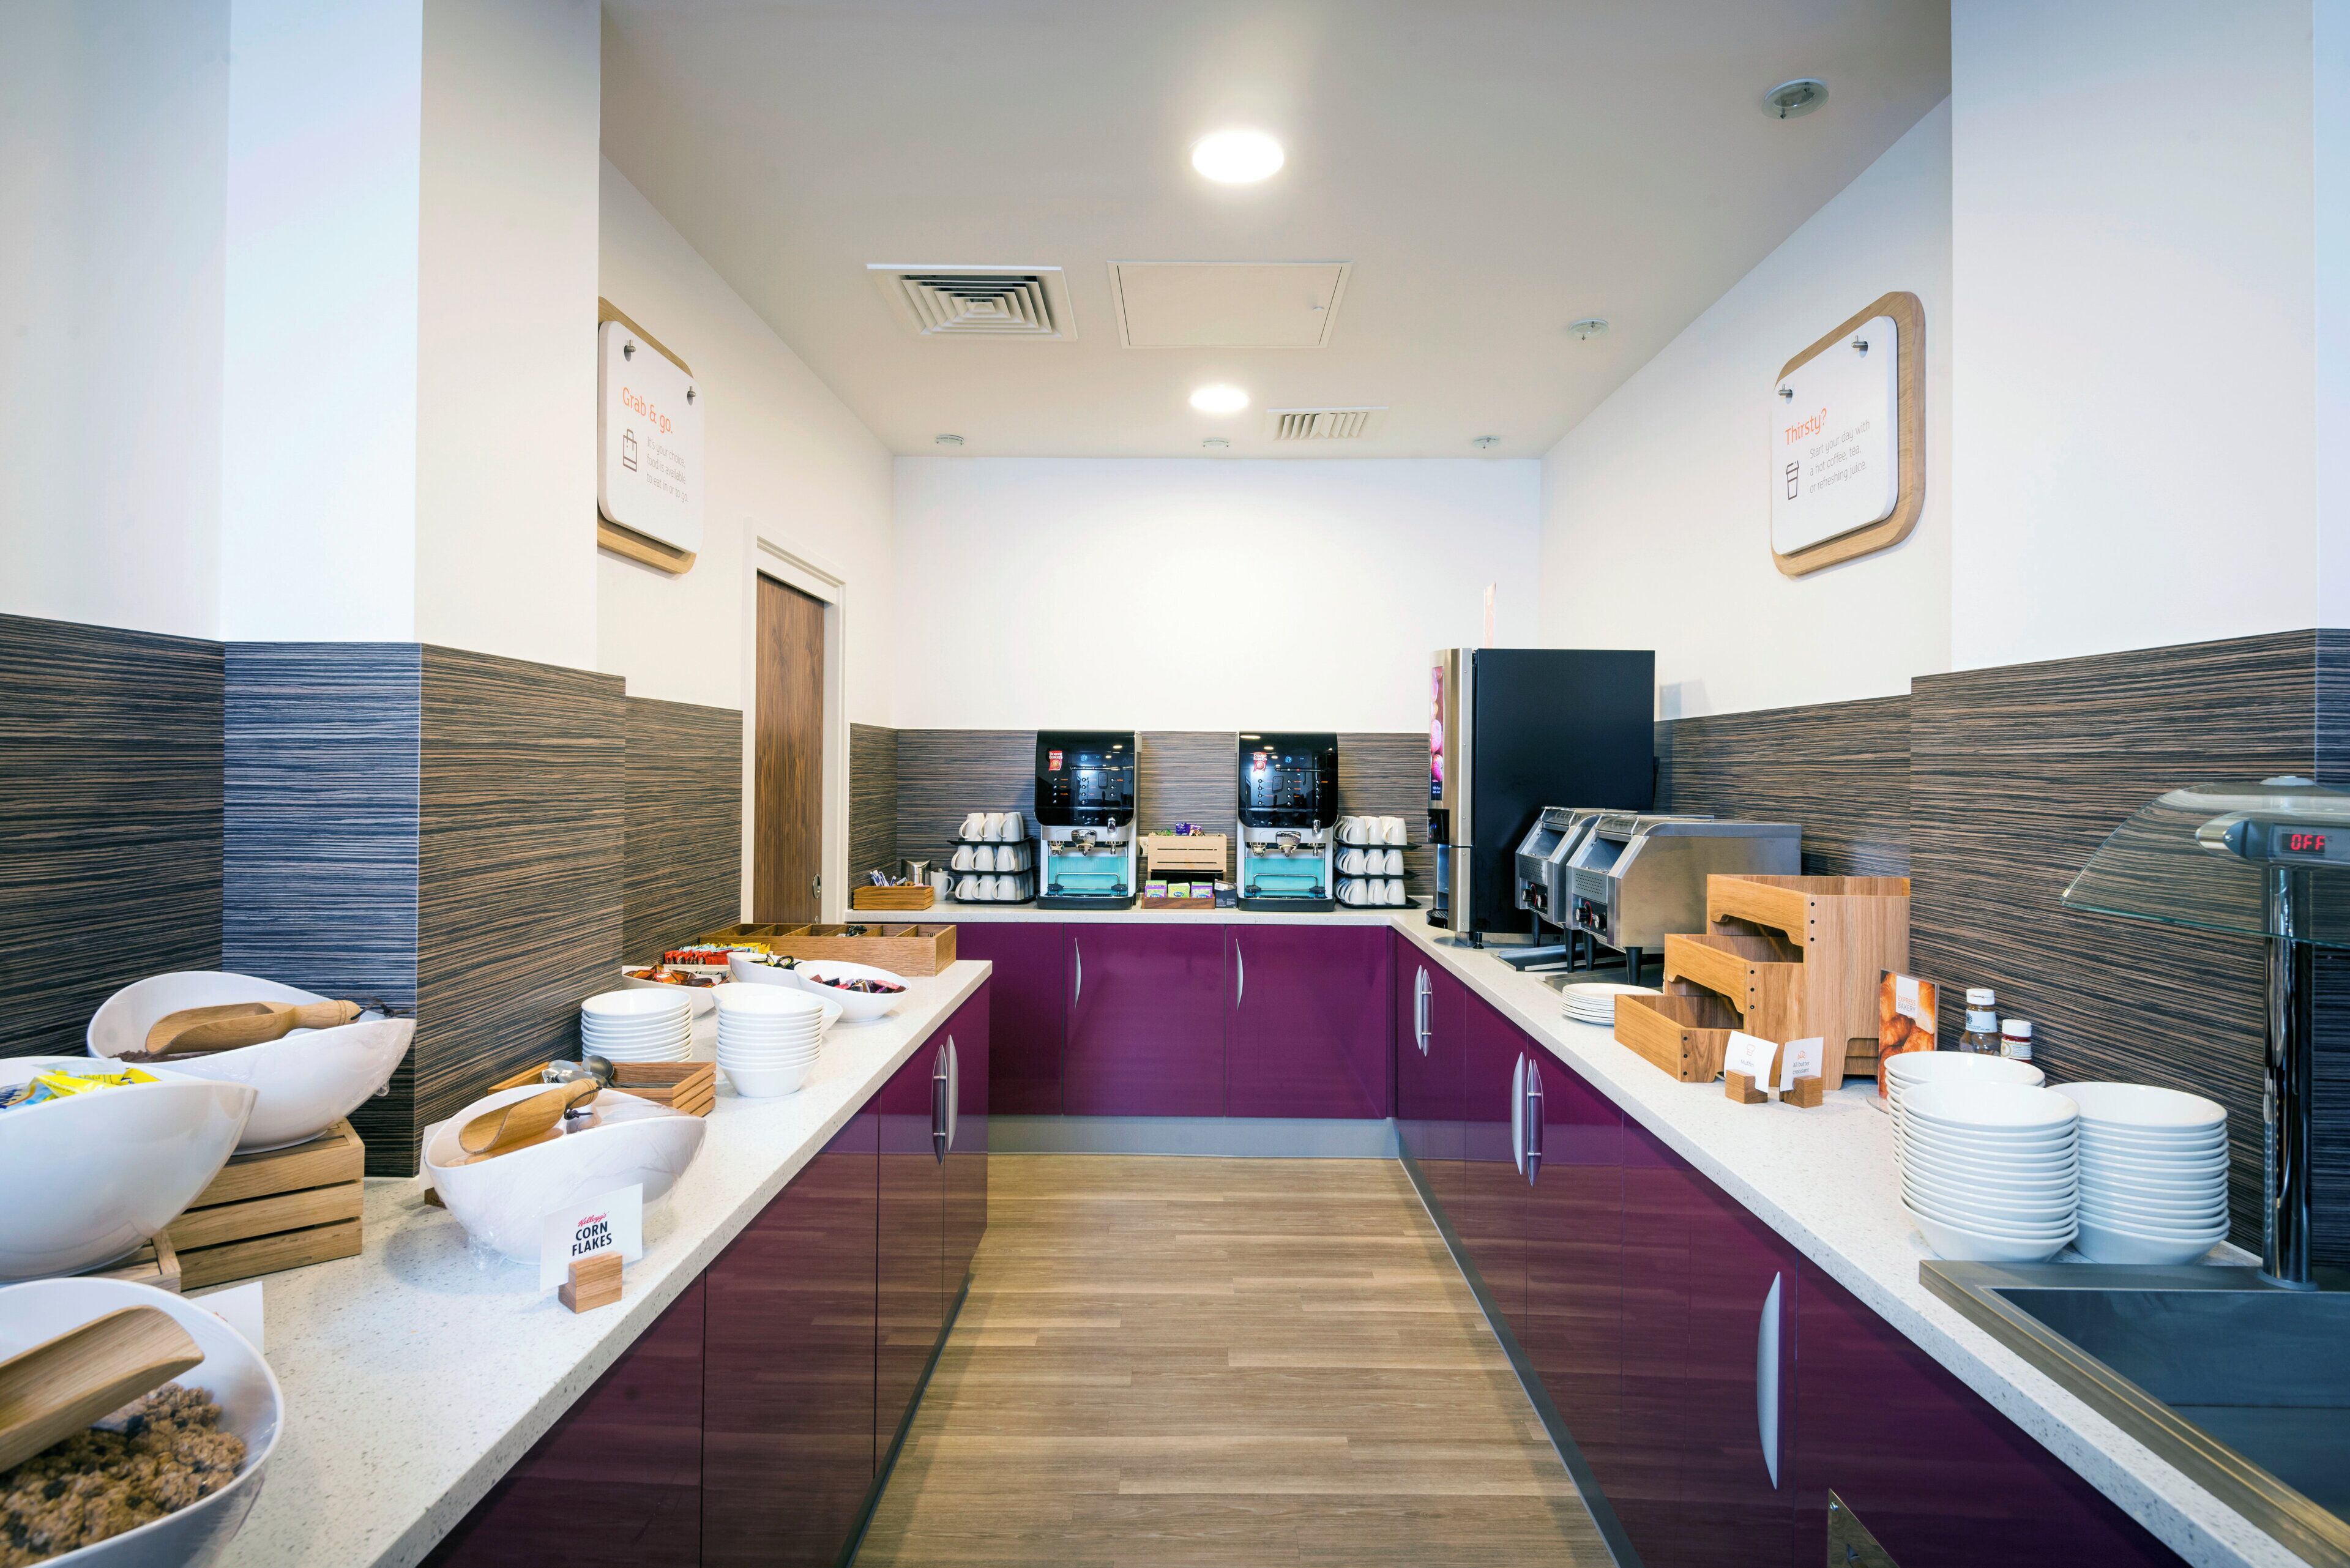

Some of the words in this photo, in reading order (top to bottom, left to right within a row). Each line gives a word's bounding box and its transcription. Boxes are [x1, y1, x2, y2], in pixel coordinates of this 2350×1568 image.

[622, 387, 646, 416] Grab
[649, 404, 657, 424] &
[660, 414, 673, 433] go.
[1785, 408, 1827, 446] Thirsty?
[1810, 444, 1824, 459] Start
[1826, 436, 1840, 454] your
[1841, 430, 1853, 442] day
[1855, 420, 1870, 435] with
[656, 443, 668, 455] your
[669, 450, 685, 468] choice,
[1810, 468, 1814, 476] a
[1815, 461, 1825, 474] hot
[1827, 452, 1848, 468] coffee,
[1849, 445, 1861, 457] tea,
[647, 454, 658, 469] food
[659, 461, 664, 472] is
[665, 465, 685, 484] available
[1810, 483, 1816, 493] or
[1818, 469, 1848, 489] refreshing
[1849, 461, 1867, 479] juice.
[647, 472, 652, 483] to
[653, 477, 662, 489] eat
[663, 480, 668, 492] in
[669, 485, 674, 495] or
[675, 488, 680, 498] to
[2291, 834, 2326, 850] OFF
[1898, 995, 1915, 1006] EXPRESS
[1898, 1002, 1915, 1013] BAKERY
[1740, 1059, 1754, 1067] Muffin
[576, 1220, 608, 1241] CORN
[578, 1212, 607, 1227] Kellogg's
[572, 1233, 612, 1256] FLAKES
